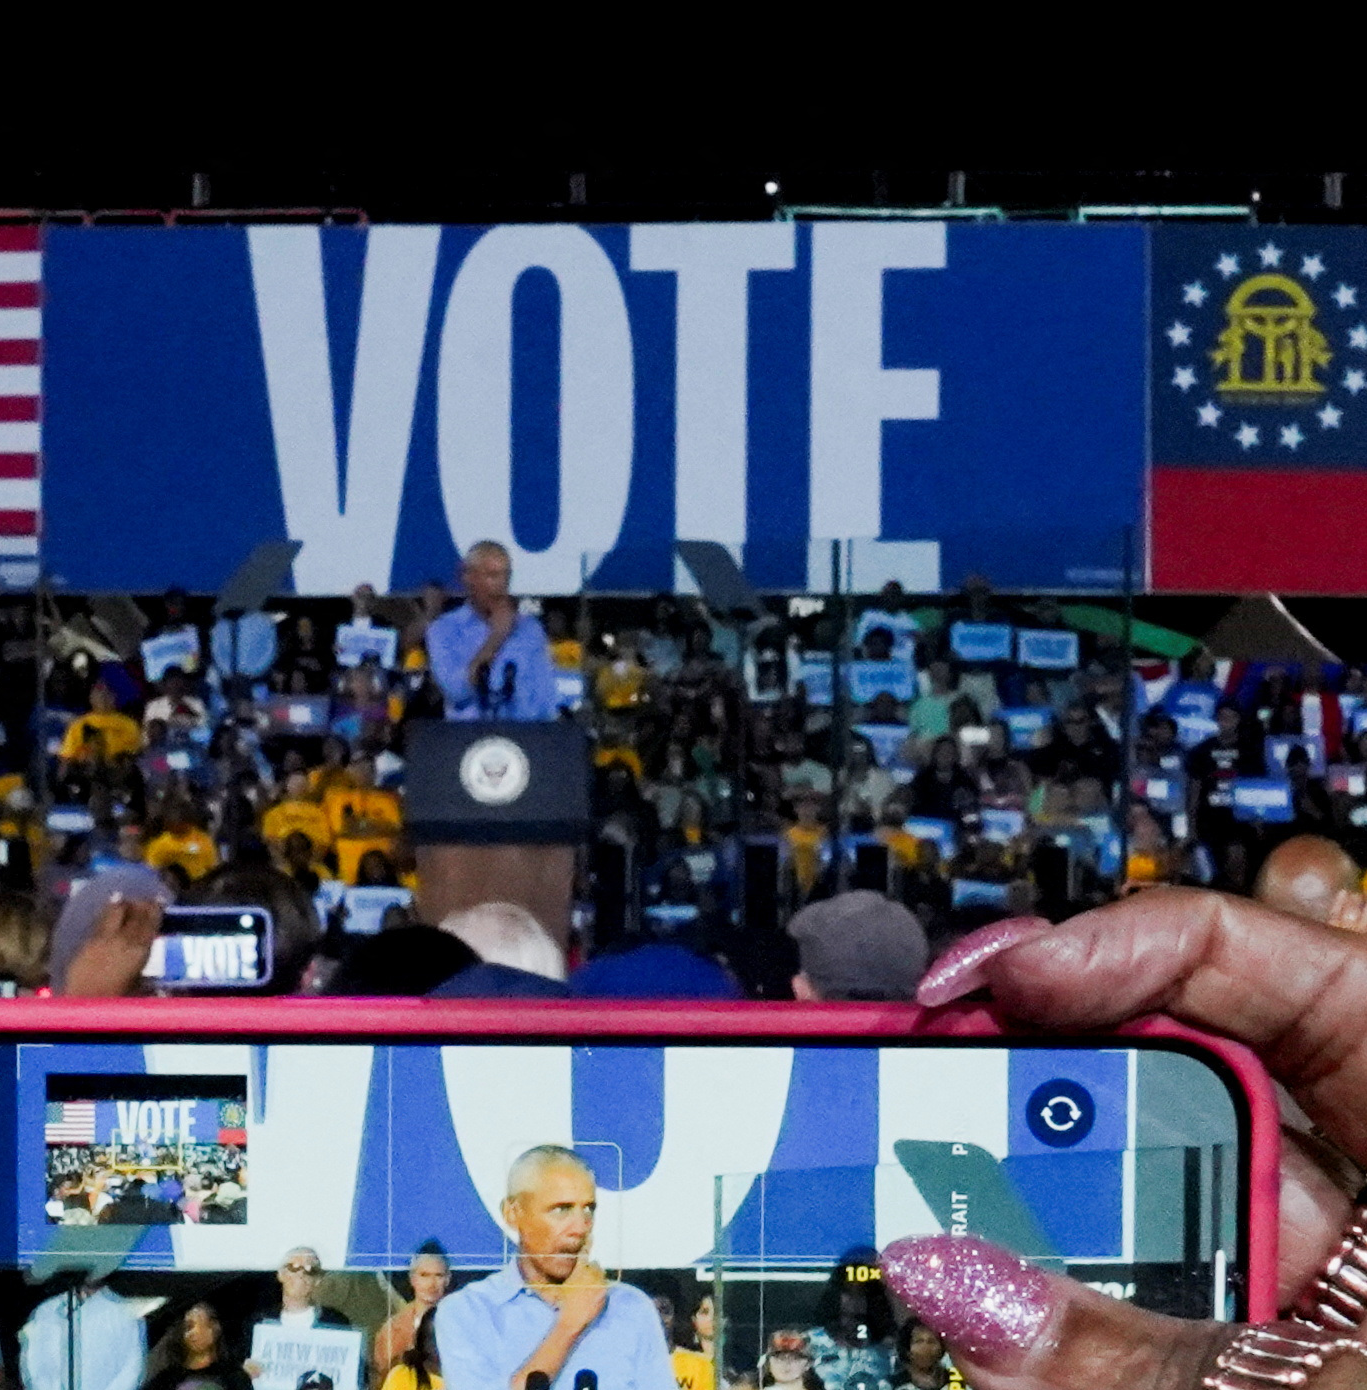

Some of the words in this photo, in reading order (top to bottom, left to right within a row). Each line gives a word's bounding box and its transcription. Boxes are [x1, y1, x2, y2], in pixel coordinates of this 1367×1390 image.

[245, 222, 948, 596] VOTE
[116, 1101, 197, 1145] VOTE
[857, 1324, 868, 1339] 2
